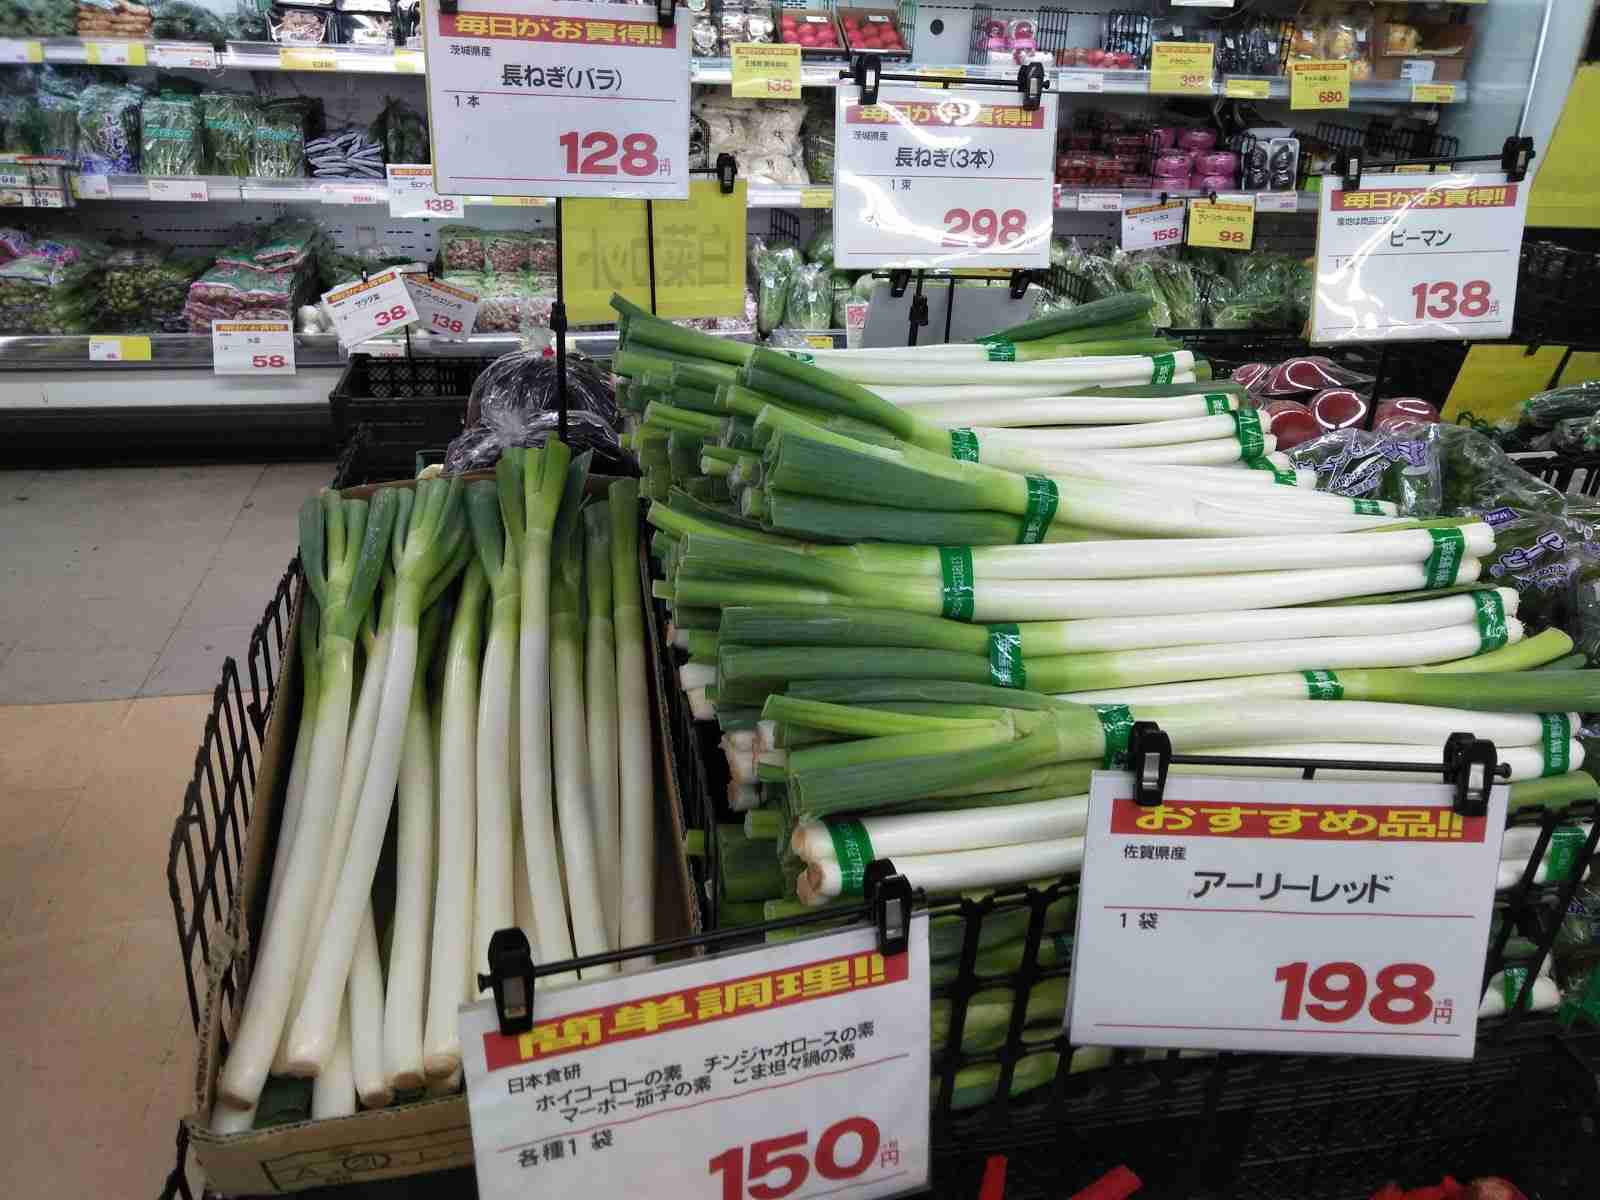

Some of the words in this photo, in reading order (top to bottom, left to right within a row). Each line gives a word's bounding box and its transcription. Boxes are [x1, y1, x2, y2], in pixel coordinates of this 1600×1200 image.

[455, 14, 663, 46] 毎日がお買得!!
[450, 45, 491, 57] 茨城県産
[501, 64, 623, 91] 長ねぎ(バラ)
[560, 131, 658, 176] 128
[895, 146, 995, 169] 長ねぎ(3本)
[424, 198, 455, 211] 138
[942, 208, 1027, 249] 298
[1152, 227, 1179, 241] 158
[1218, 230, 1244, 242] 98
[1412, 280, 1490, 319] 138
[374, 305, 407, 326] 38
[432, 313, 463, 333] 138
[253, 355, 284, 368] 58
[1136, 805, 1463, 839] おすすめ品!!
[1124, 844, 1187, 861] 佐賀県産
[1193, 871, 1394, 904] アーリーレッド
[1275, 961, 1435, 1024] 198
[507, 1063, 581, 1095] 日本食研
[536, 1064, 683, 1113] ホイコーローの素
[704, 1019, 875, 1075] チンジャオロースの素
[709, 1116, 880, 1200] 150
